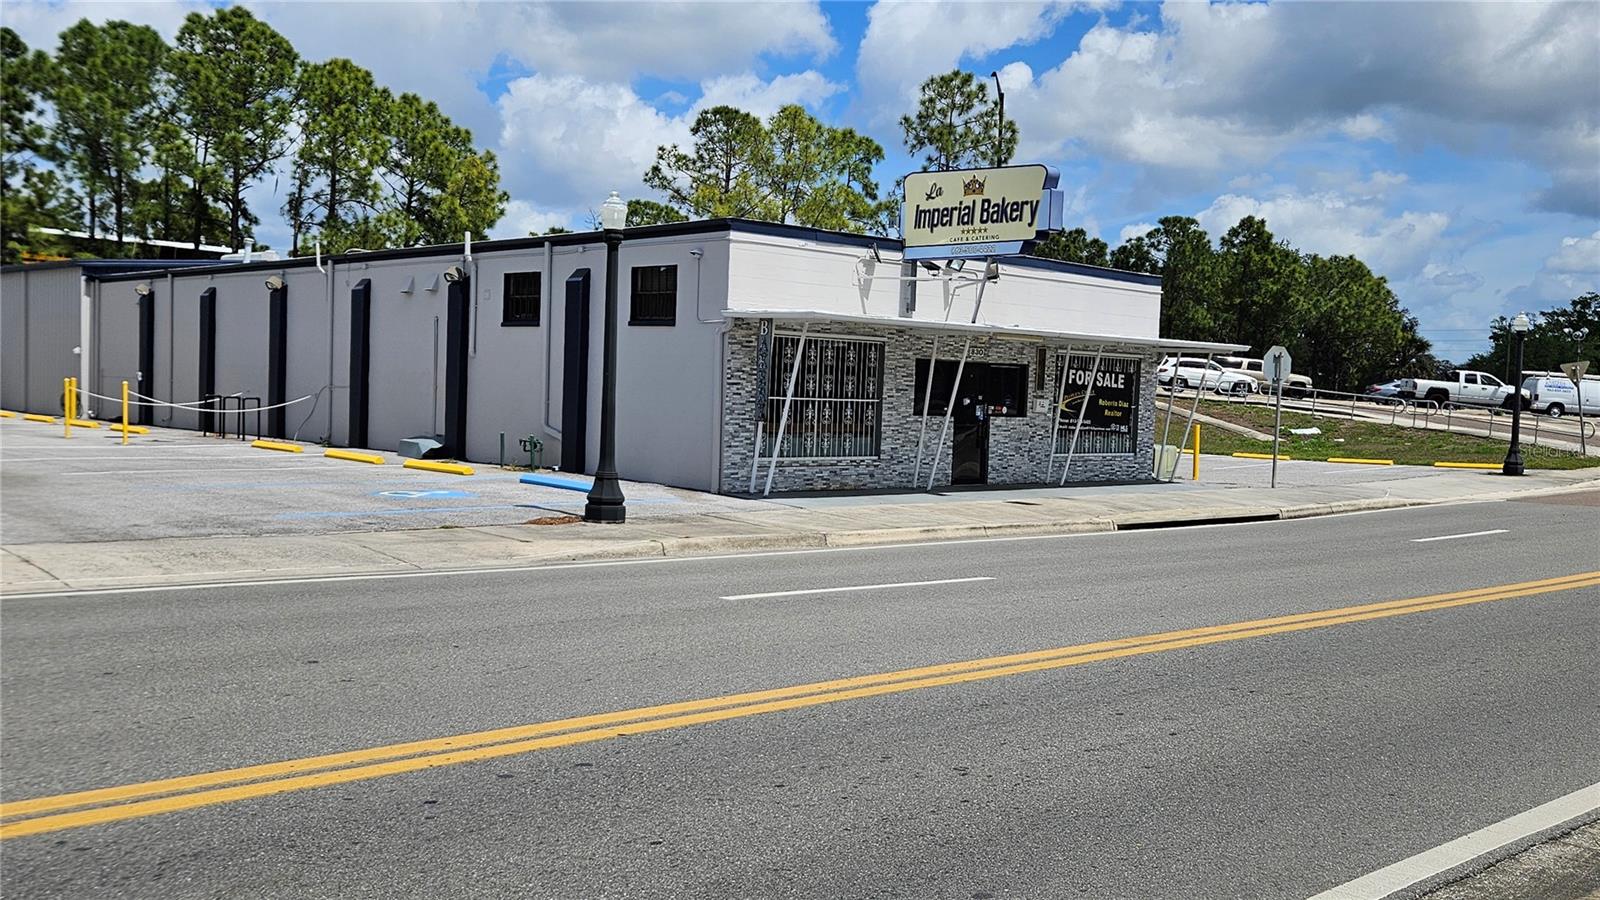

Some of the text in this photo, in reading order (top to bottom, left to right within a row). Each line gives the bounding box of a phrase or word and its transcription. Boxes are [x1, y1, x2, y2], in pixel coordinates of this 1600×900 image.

[925, 183, 943, 201] La
[914, 197, 1040, 233] Imperial Bakery
[1068, 369, 1125, 389] FOR SALE
[1104, 409, 1122, 417] Realtor
